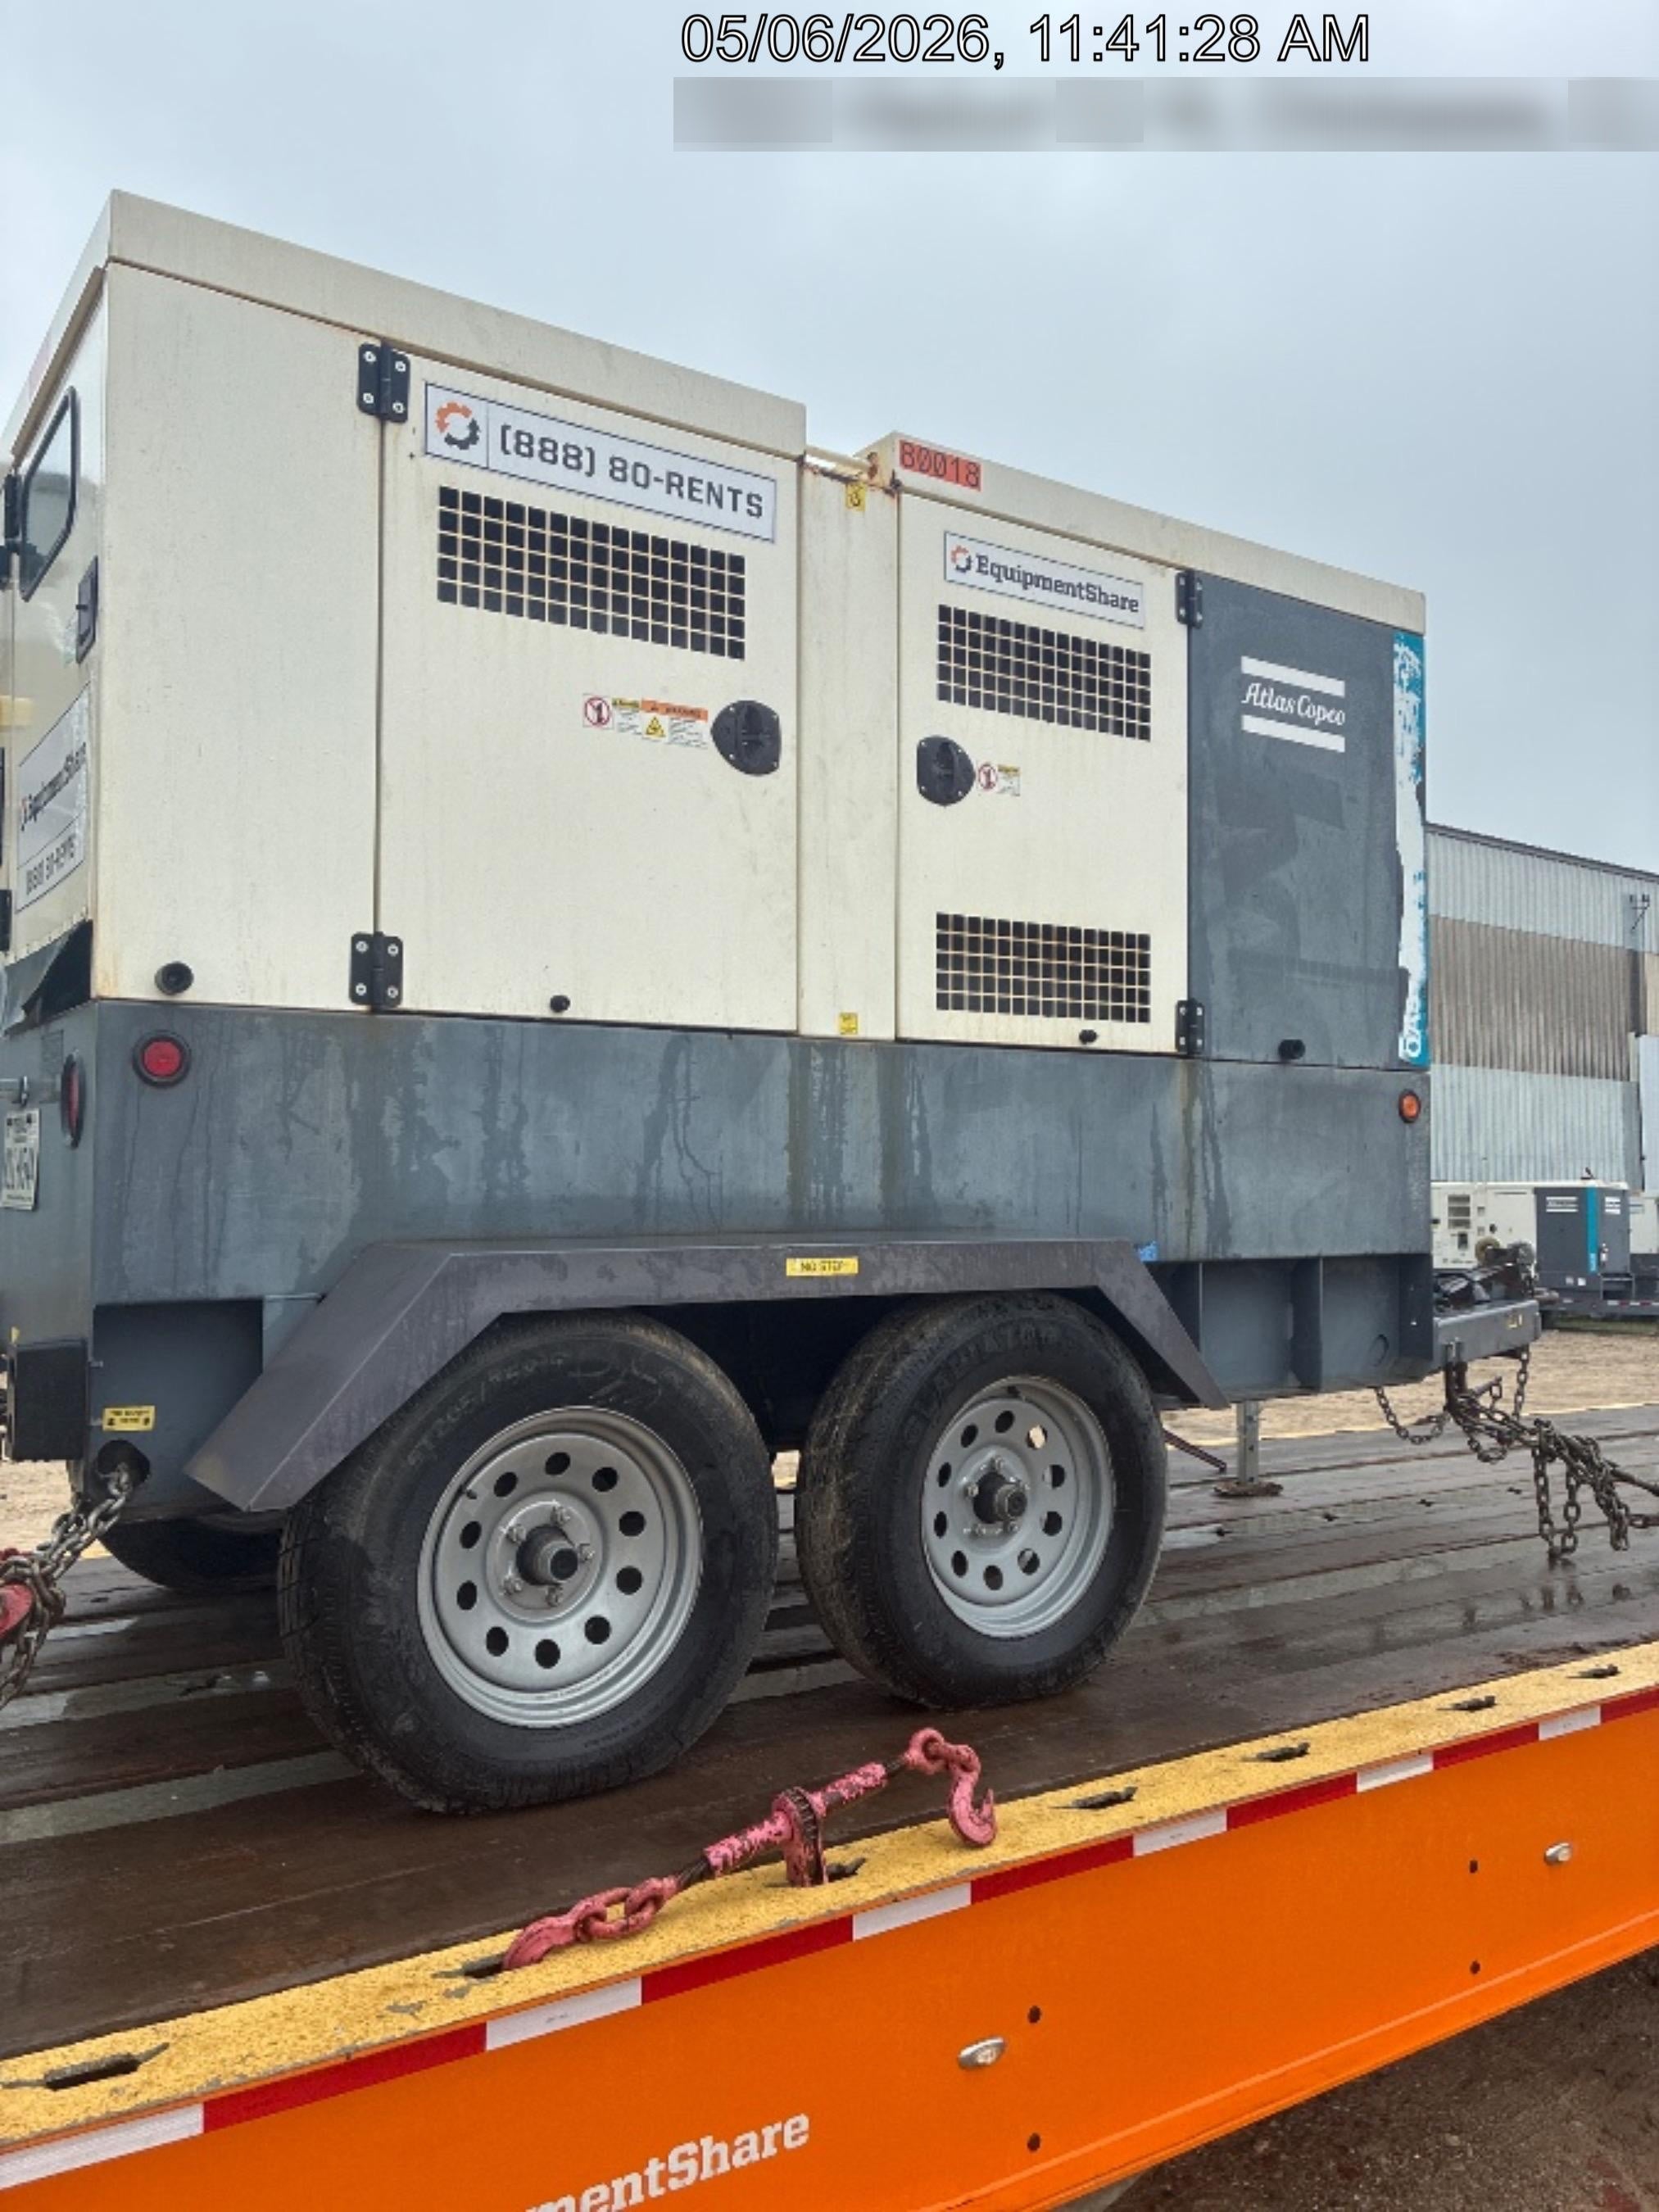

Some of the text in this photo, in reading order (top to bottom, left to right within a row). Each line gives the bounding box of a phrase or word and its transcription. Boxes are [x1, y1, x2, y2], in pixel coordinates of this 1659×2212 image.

[500, 423, 764, 519] (888) 80-RENTS
[974, 551, 1140, 614] EquipmentShare
[1241, 682, 1345, 727] Atlas Copco
[525, 2113, 809, 2212] entShare
